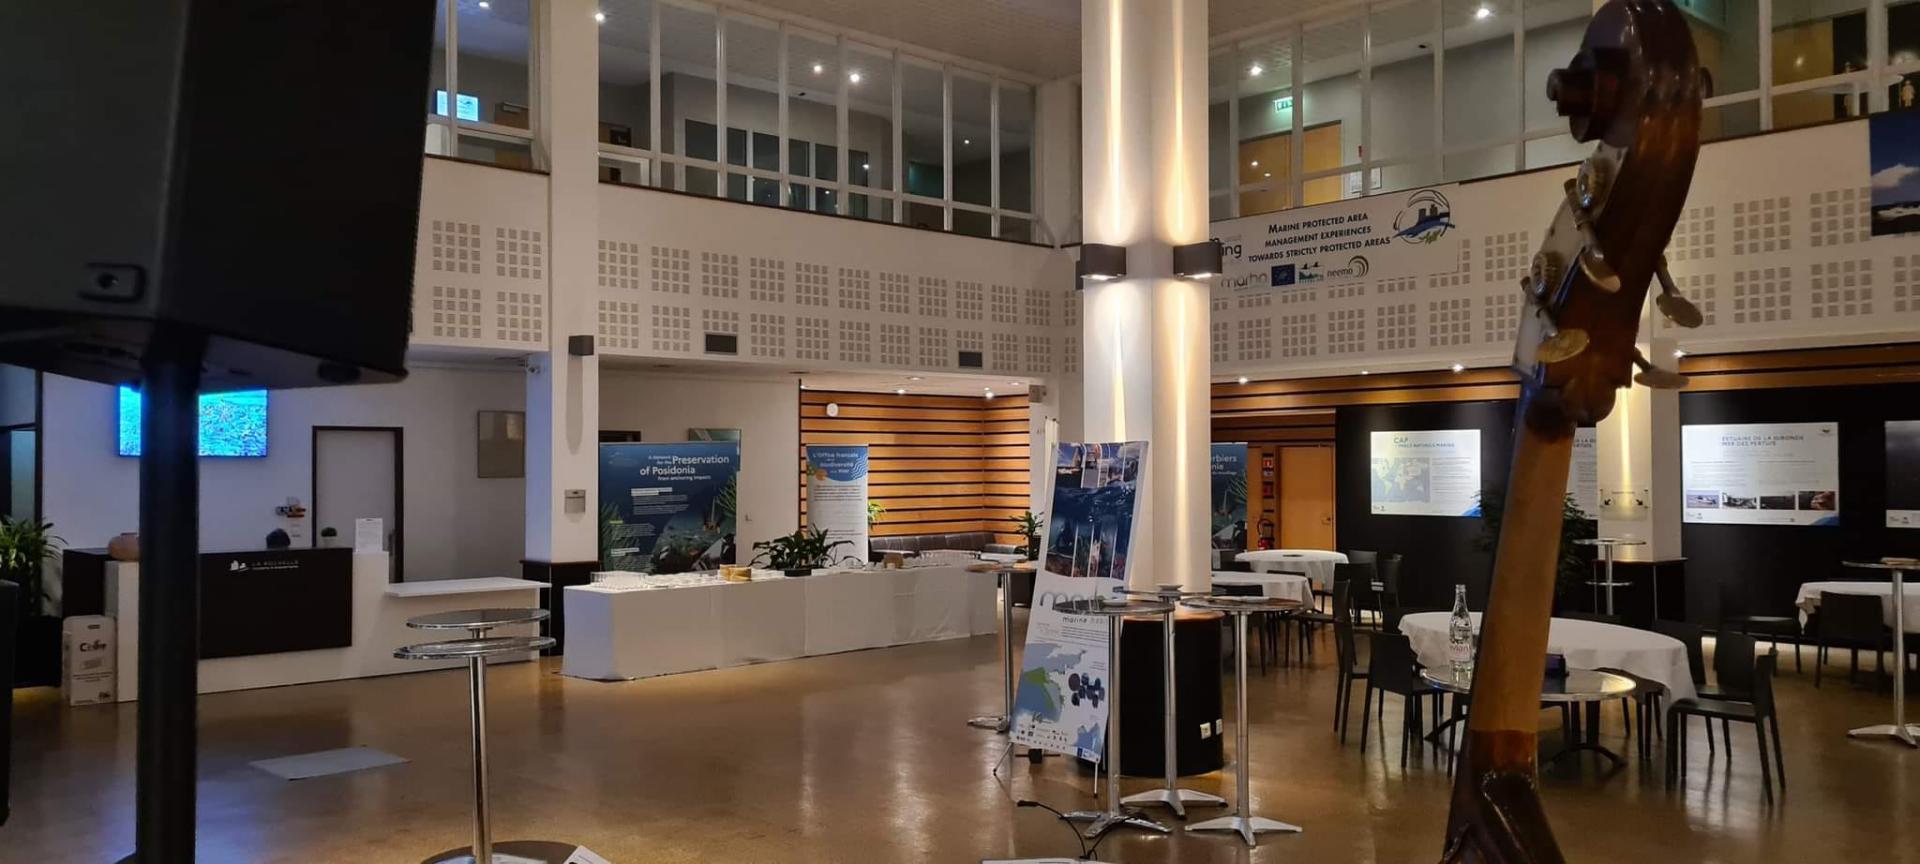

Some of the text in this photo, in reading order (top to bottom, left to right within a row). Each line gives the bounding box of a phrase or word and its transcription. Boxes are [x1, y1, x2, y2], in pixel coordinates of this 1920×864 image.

[1268, 212, 1369, 234] MARINE PROTECTED AREA
[1265, 225, 1372, 248] MANAGEMENT EXPERIENCES
[1248, 237, 1391, 263] TOWARDS STRICTLY PROTECTED AREAS
[672, 454, 730, 465] Preservation
[1212, 454, 1237, 462] rbiers
[640, 465, 696, 476] of Posidonia
